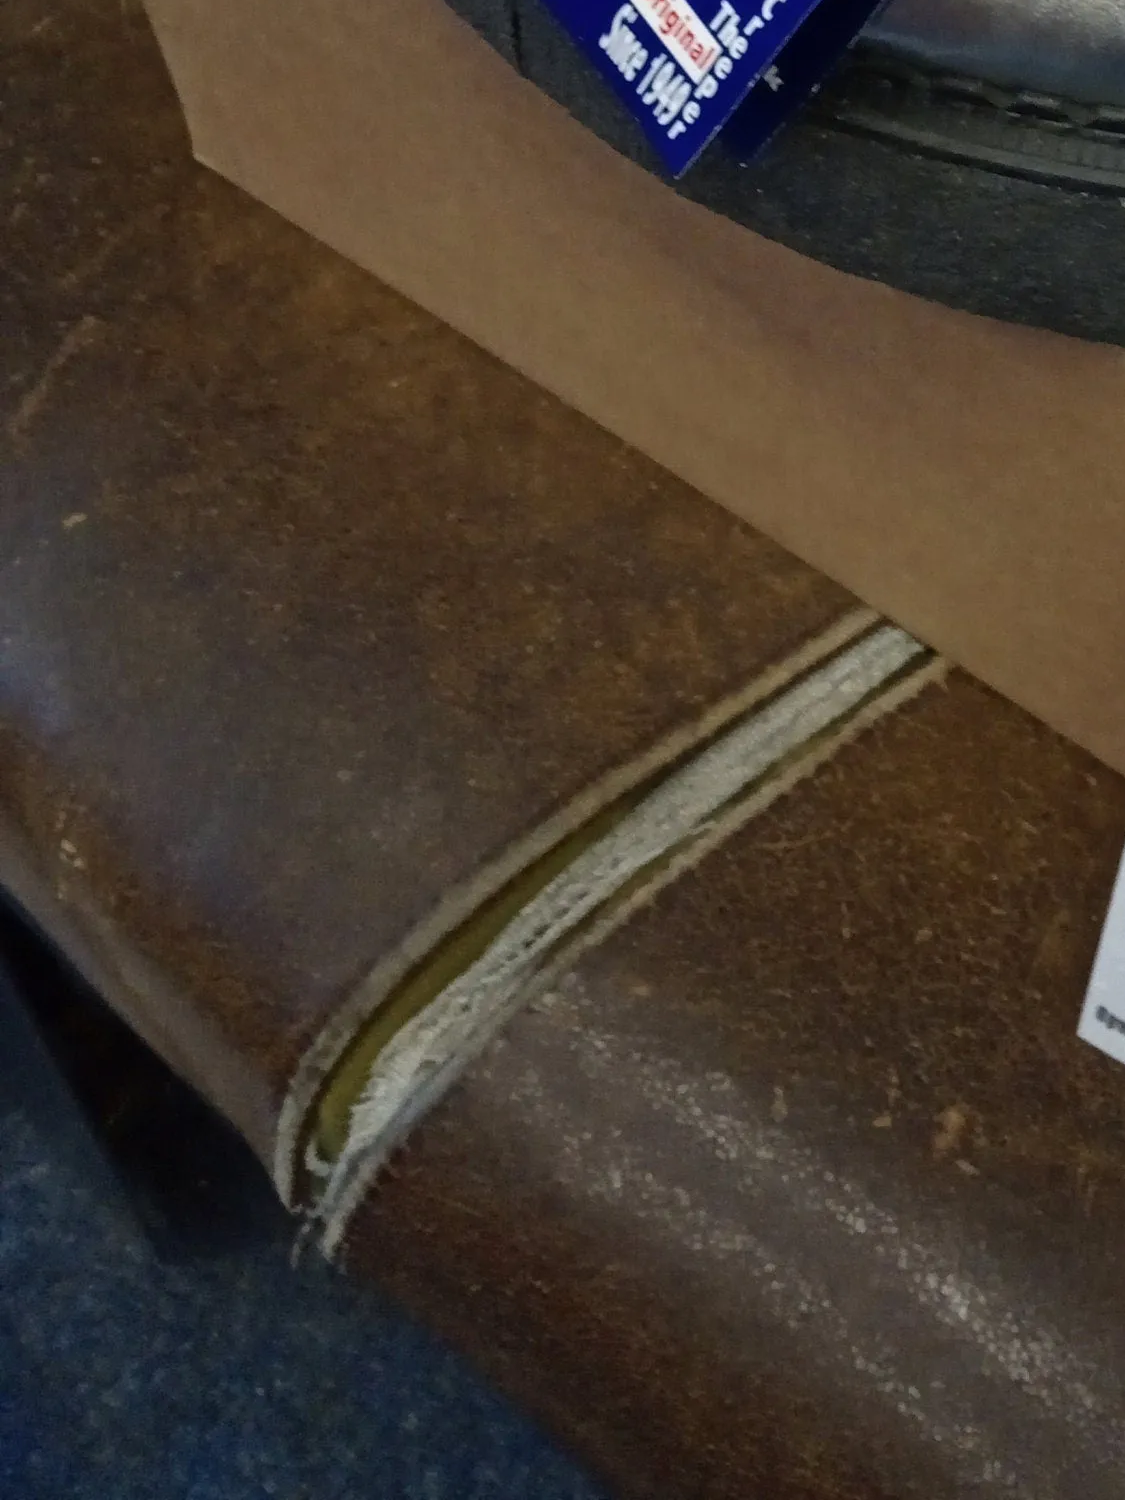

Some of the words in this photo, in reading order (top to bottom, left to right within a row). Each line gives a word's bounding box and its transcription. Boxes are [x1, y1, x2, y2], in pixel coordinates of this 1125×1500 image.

[598, 3, 649, 82] Since
[636, 53, 692, 126] 1949
[709, 0, 749, 60] The
